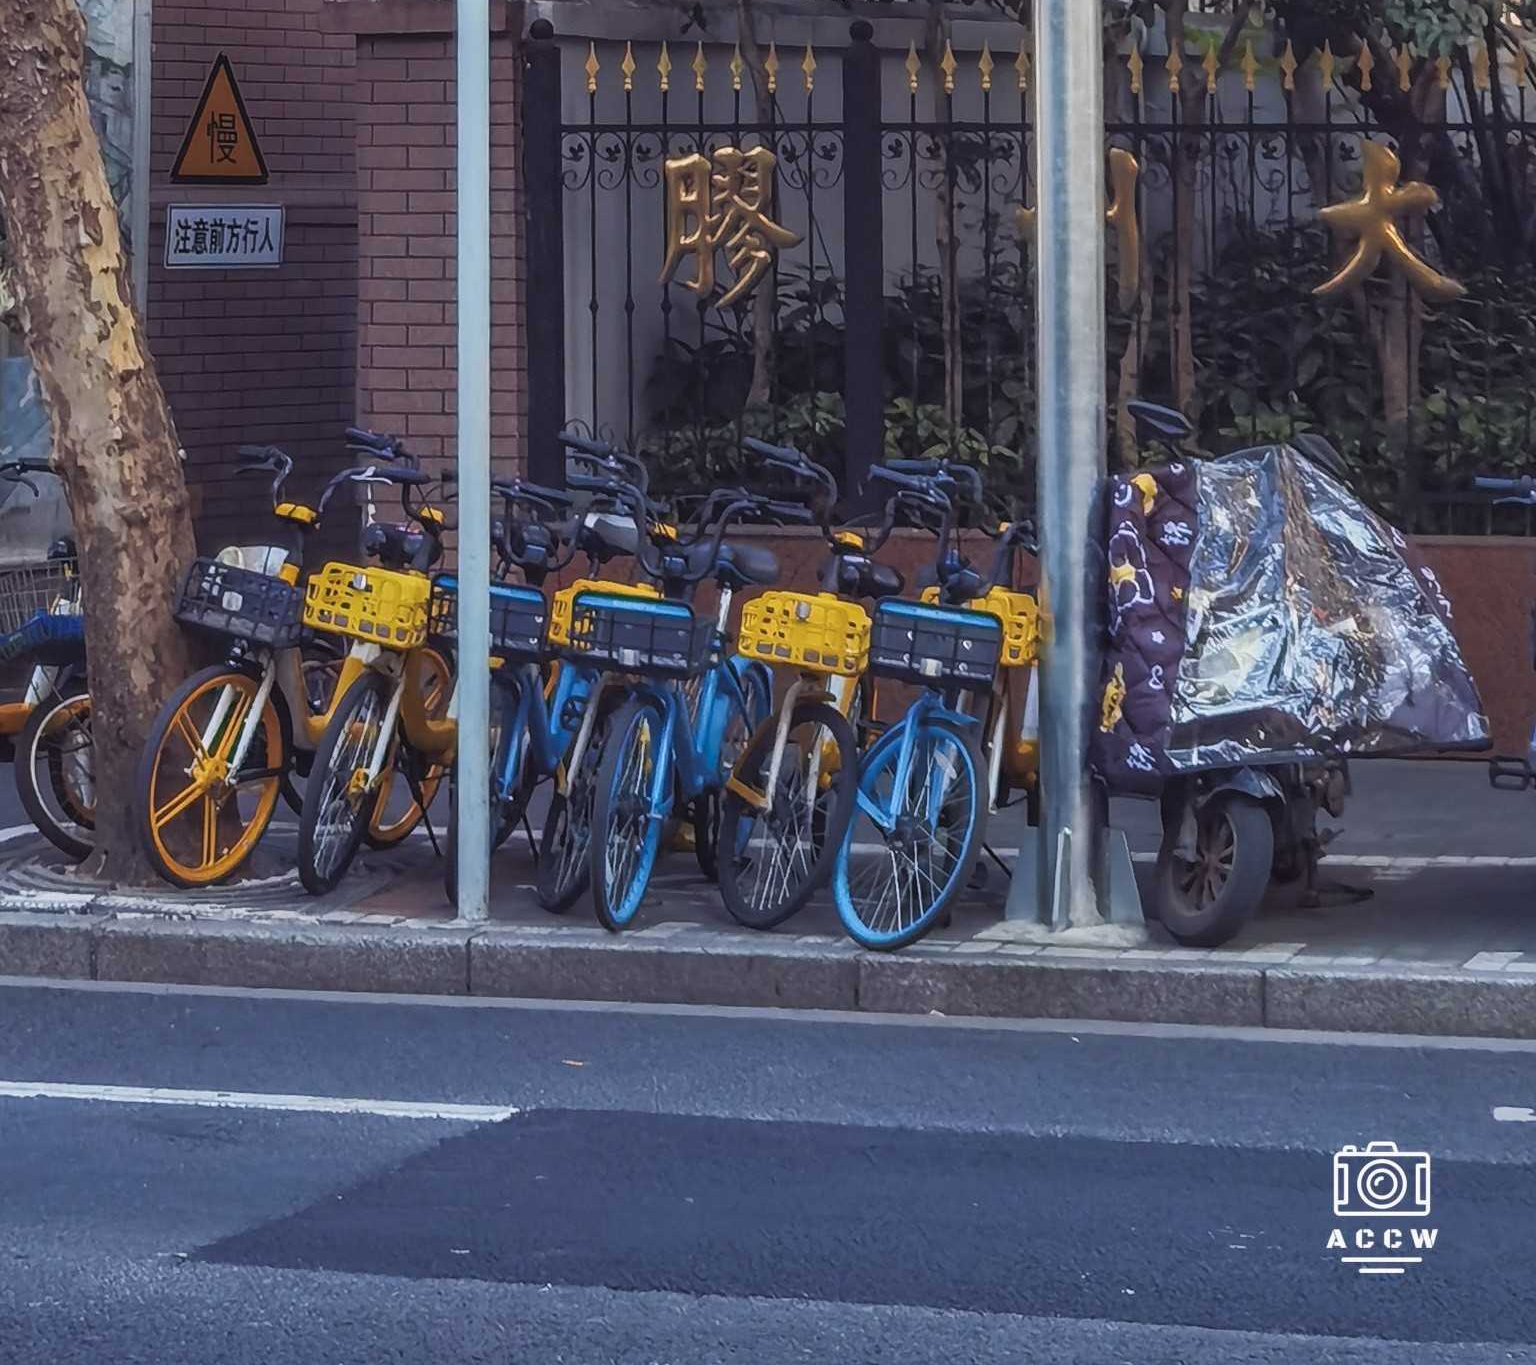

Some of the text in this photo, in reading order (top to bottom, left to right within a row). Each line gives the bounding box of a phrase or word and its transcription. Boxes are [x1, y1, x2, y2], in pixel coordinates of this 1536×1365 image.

[206, 110, 239, 164] 慢
[173, 217, 275, 256] 注意前方行人
